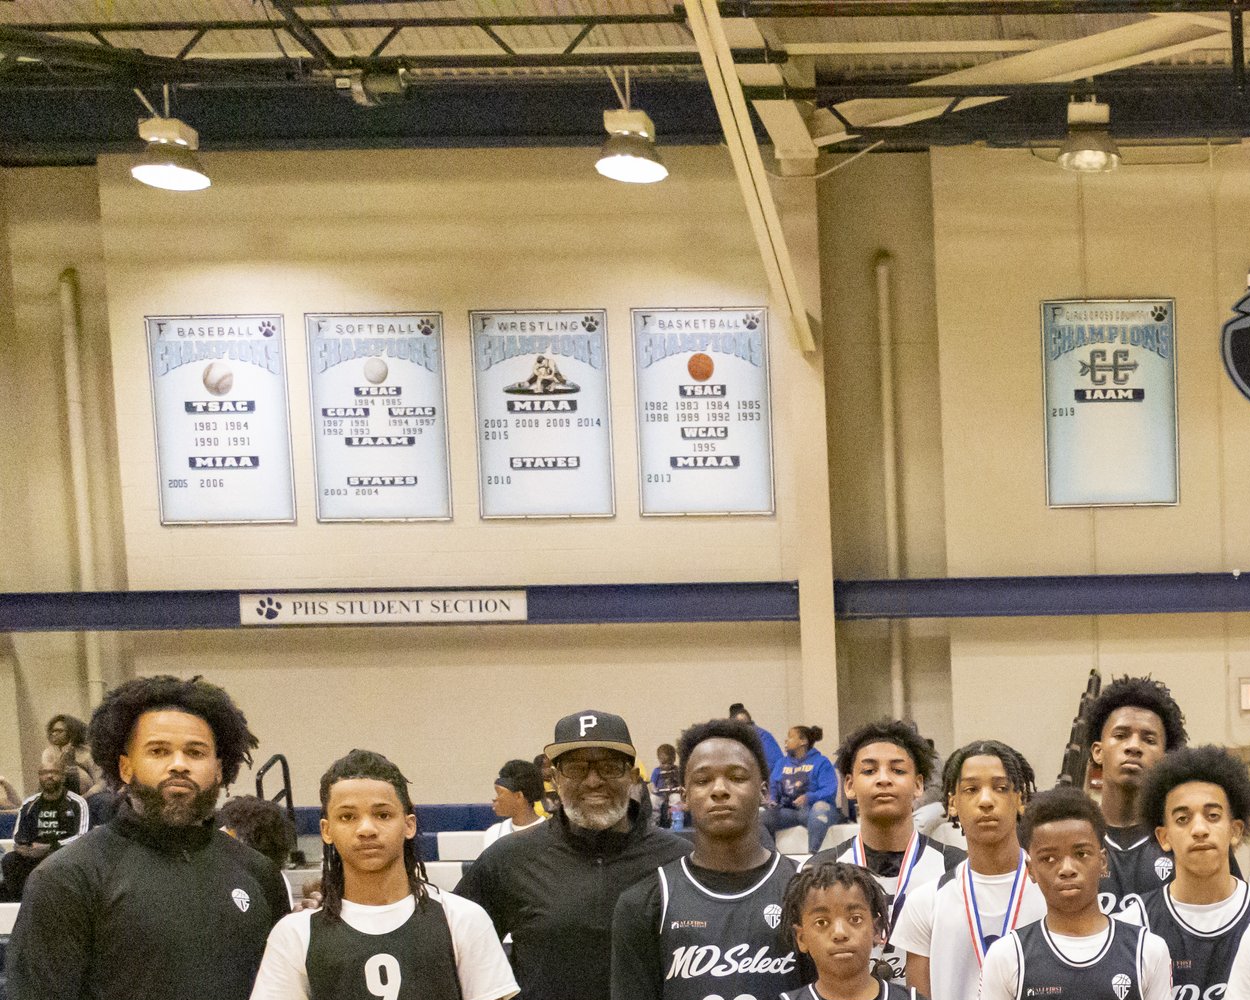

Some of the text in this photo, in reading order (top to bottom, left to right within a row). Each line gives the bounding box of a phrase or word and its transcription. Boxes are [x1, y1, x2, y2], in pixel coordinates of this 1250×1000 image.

[335, 323, 414, 334] SOFTBALL
[497, 319, 579, 332] WRESTLING
[658, 318, 740, 329] BASKETBALL
[177, 326, 253, 337] BASEBALL
[1050, 324, 1169, 360] CHAMPIONS
[359, 387, 397, 395] TSAC
[683, 385, 721, 395] TSAC
[1085, 389, 1133, 400] IAAM
[192, 402, 247, 412] TSAC
[513, 400, 570, 411] MIAA
[644, 400, 761, 411] 1982 1983 1984 1985
[390, 407, 433, 415] WCAC
[1052, 407, 1076, 417] 2019
[645, 412, 761, 422] 1988 1989 1992 1993
[225, 421, 249, 431] 1984
[577, 418, 601, 427] 2014
[684, 427, 727, 437] WCAC
[194, 437, 251, 447] 1990 1991
[352, 437, 408, 446] IAAM
[692, 443, 716, 453] 1995
[195, 457, 253, 468] MIAA
[513, 457, 579, 467] STATES
[677, 457, 734, 467] MIAA
[168, 479, 224, 488] 2005 2006
[349, 477, 416, 485] STATES
[487, 475, 512, 485] 2010
[647, 474, 671, 483] 2013
[292, 598, 512, 615] PHS STUDENT SECTION
[579, 715, 598, 737] P
